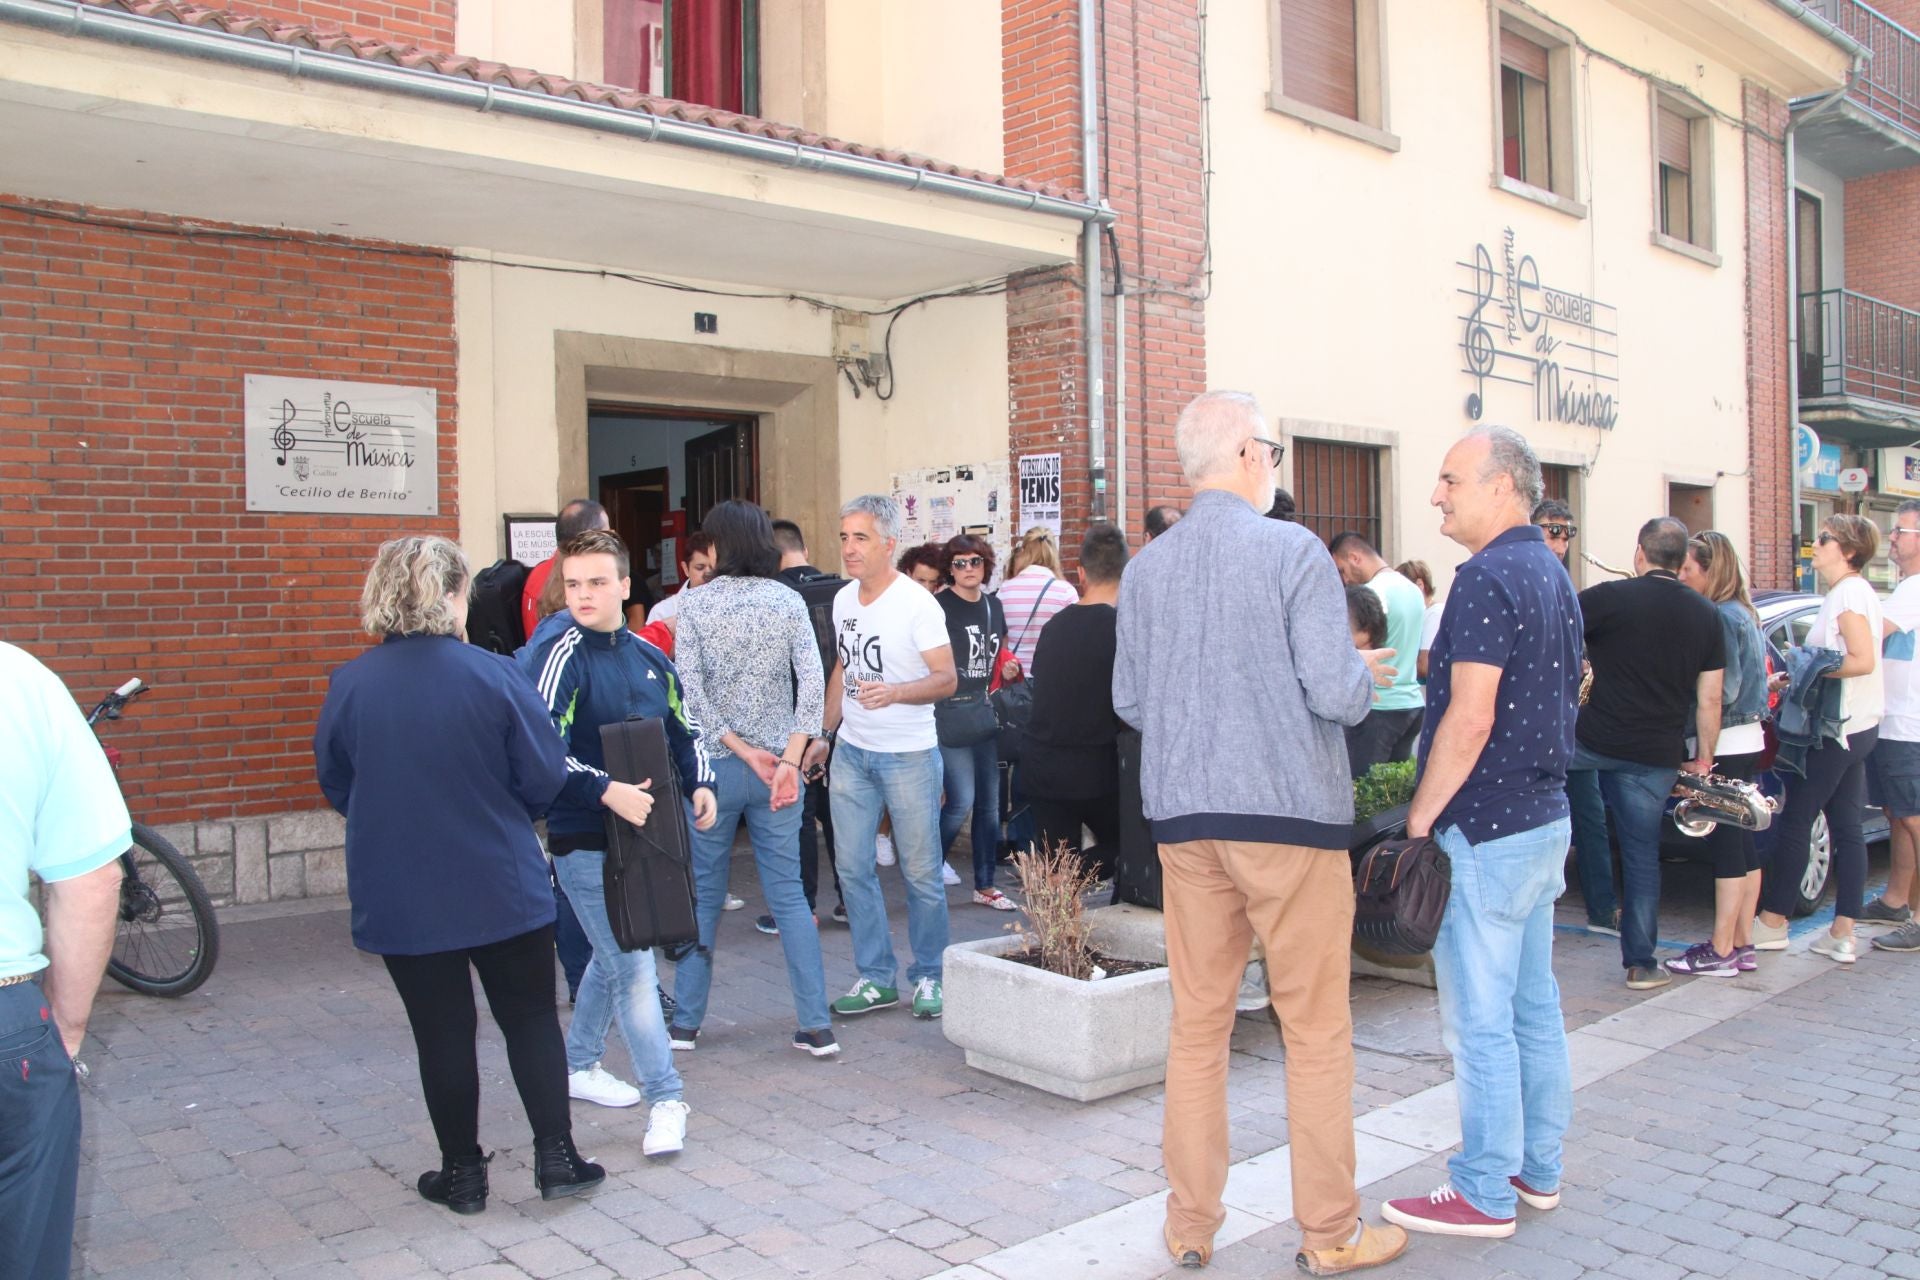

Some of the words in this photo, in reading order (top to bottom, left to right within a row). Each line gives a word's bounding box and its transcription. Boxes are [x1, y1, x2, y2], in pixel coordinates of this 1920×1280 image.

[1536, 319, 1562, 355] de
[346, 425, 367, 440] de
[1021, 458, 1050, 477] CURSILLOS
[1052, 457, 1059, 476] DE
[337, 487, 355, 498] de
[1021, 476, 1059, 503] TENIS
[514, 530, 523, 538] LA
[525, 530, 556, 538] ESCUEL
[518, 540, 528, 548] DE
[530, 540, 557, 548] MUSIC
[515, 550, 528, 559] NO
[529, 550, 540, 559] SE
[542, 550, 553, 558] TO
[841, 618, 857, 632] THE
[965, 624, 980, 635] THE
[863, 986, 881, 1004] N
